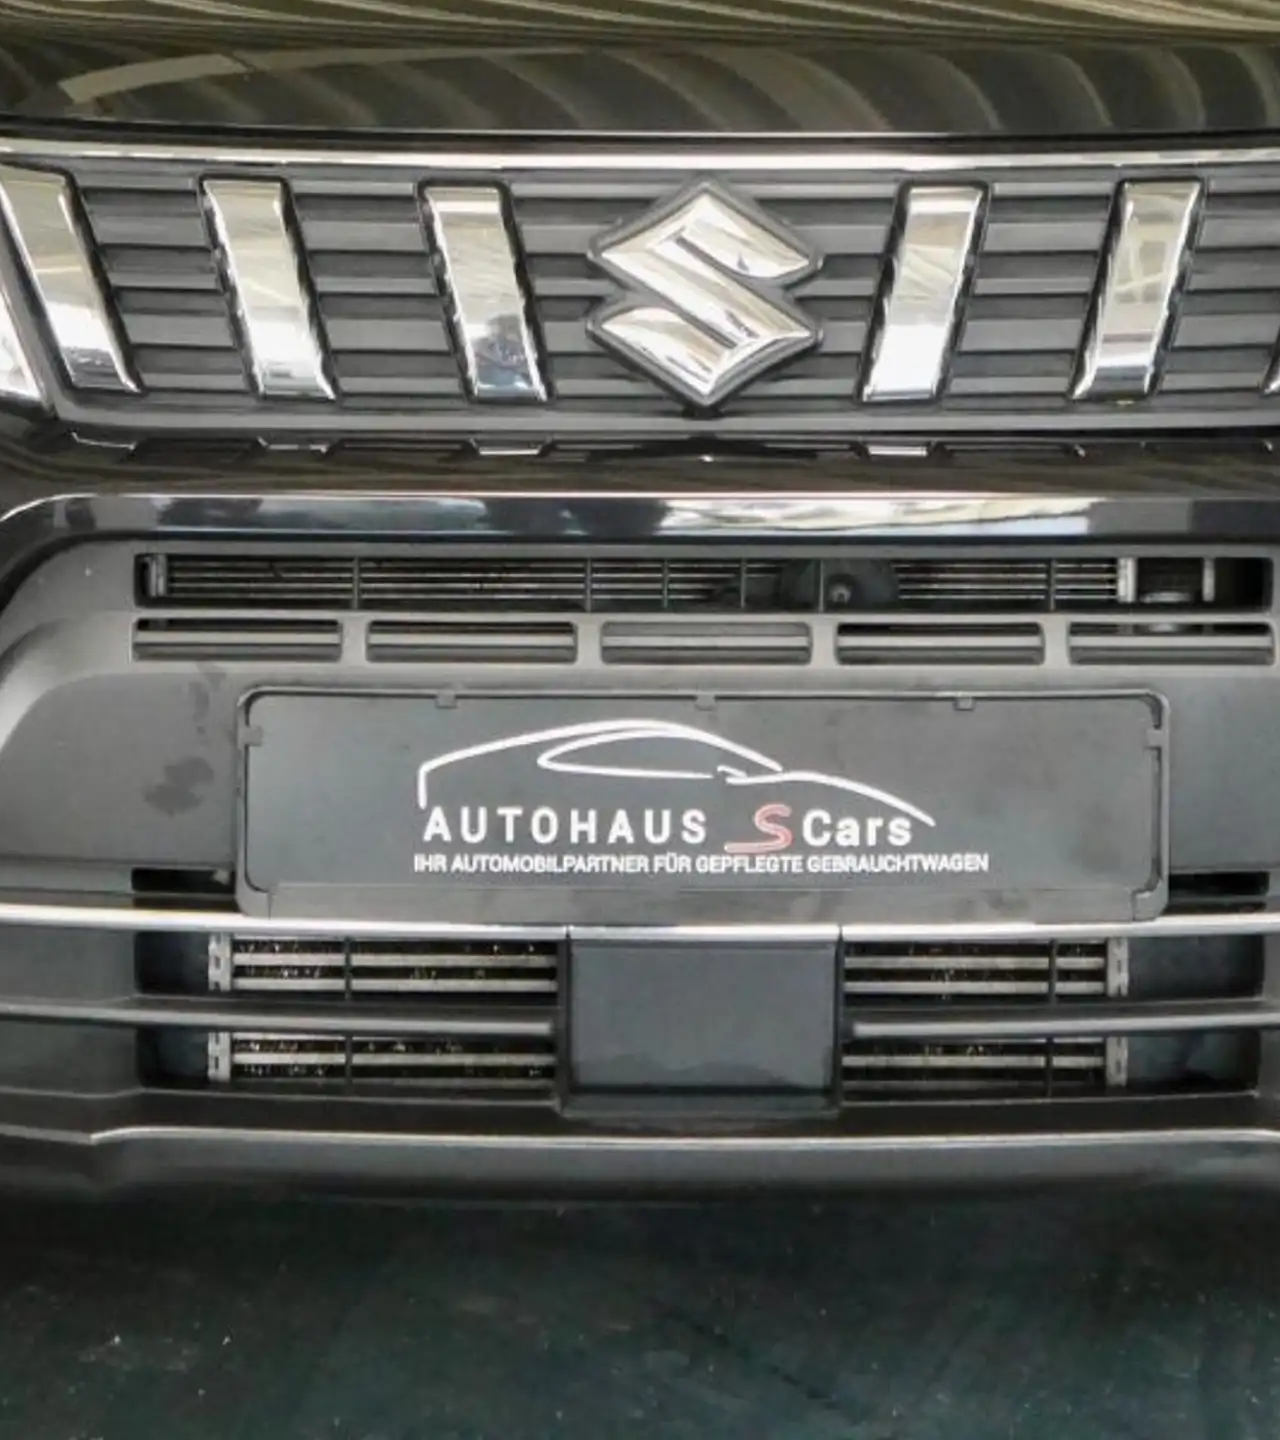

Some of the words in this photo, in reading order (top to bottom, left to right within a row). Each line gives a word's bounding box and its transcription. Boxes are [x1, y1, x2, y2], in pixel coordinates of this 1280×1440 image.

[423, 805, 707, 845] AUTOHAUS
[725, 803, 793, 853] S
[802, 808, 912, 847] Cars
[414, 853, 447, 872] IHR
[451, 853, 649, 873] AUTOMOBILPARTNER
[654, 851, 691, 873] FÜR
[696, 854, 803, 873] GEPFLEGTE
[807, 853, 989, 873] GEBRAUCHTWAGEN
